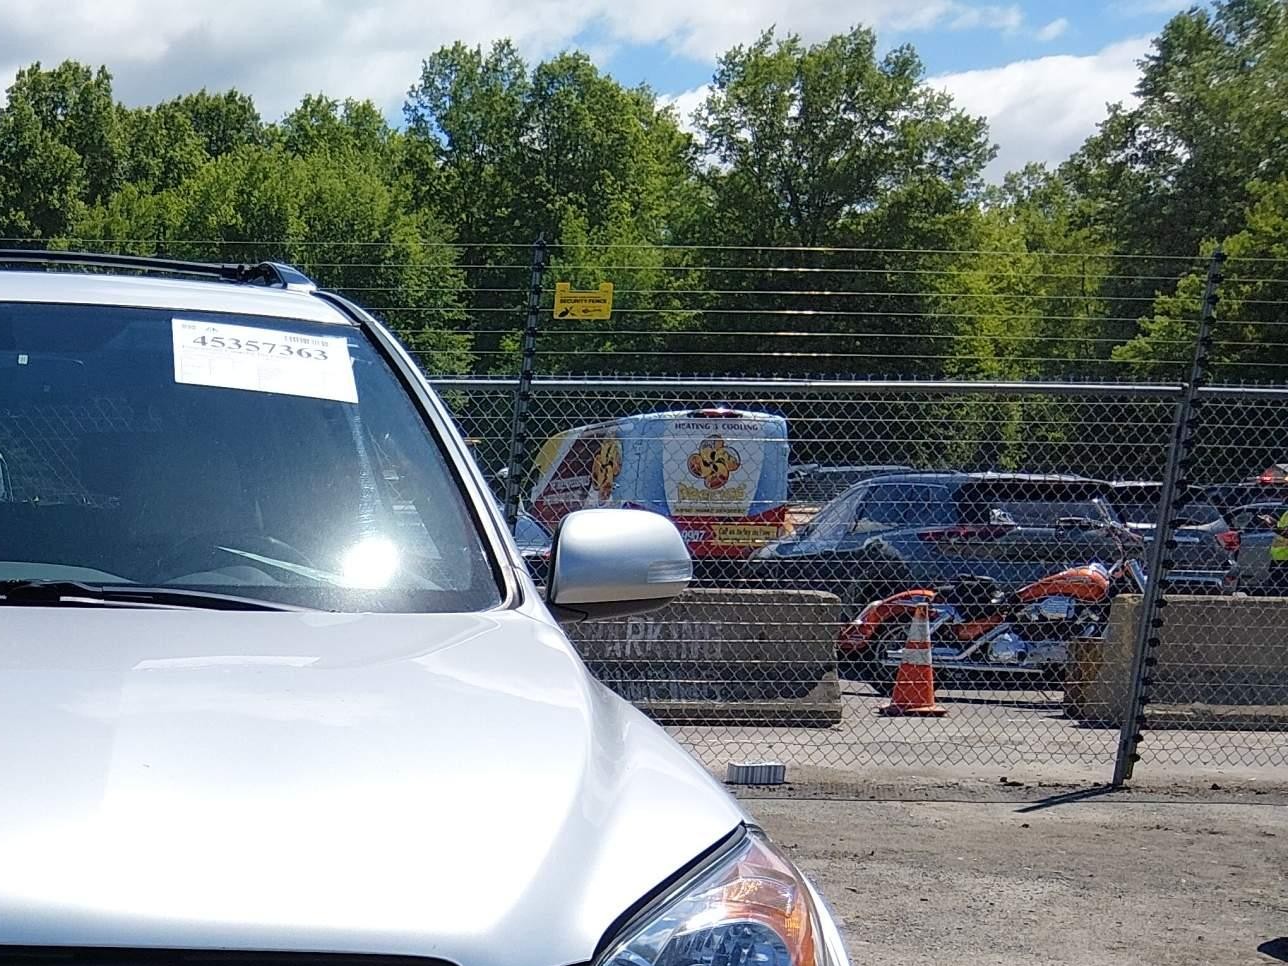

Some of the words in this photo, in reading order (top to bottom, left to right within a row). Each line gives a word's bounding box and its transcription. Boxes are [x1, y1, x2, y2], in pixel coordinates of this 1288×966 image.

[193, 335, 329, 361] 45357363
[675, 422, 711, 430] HEATING
[722, 423, 759, 431] COOLING
